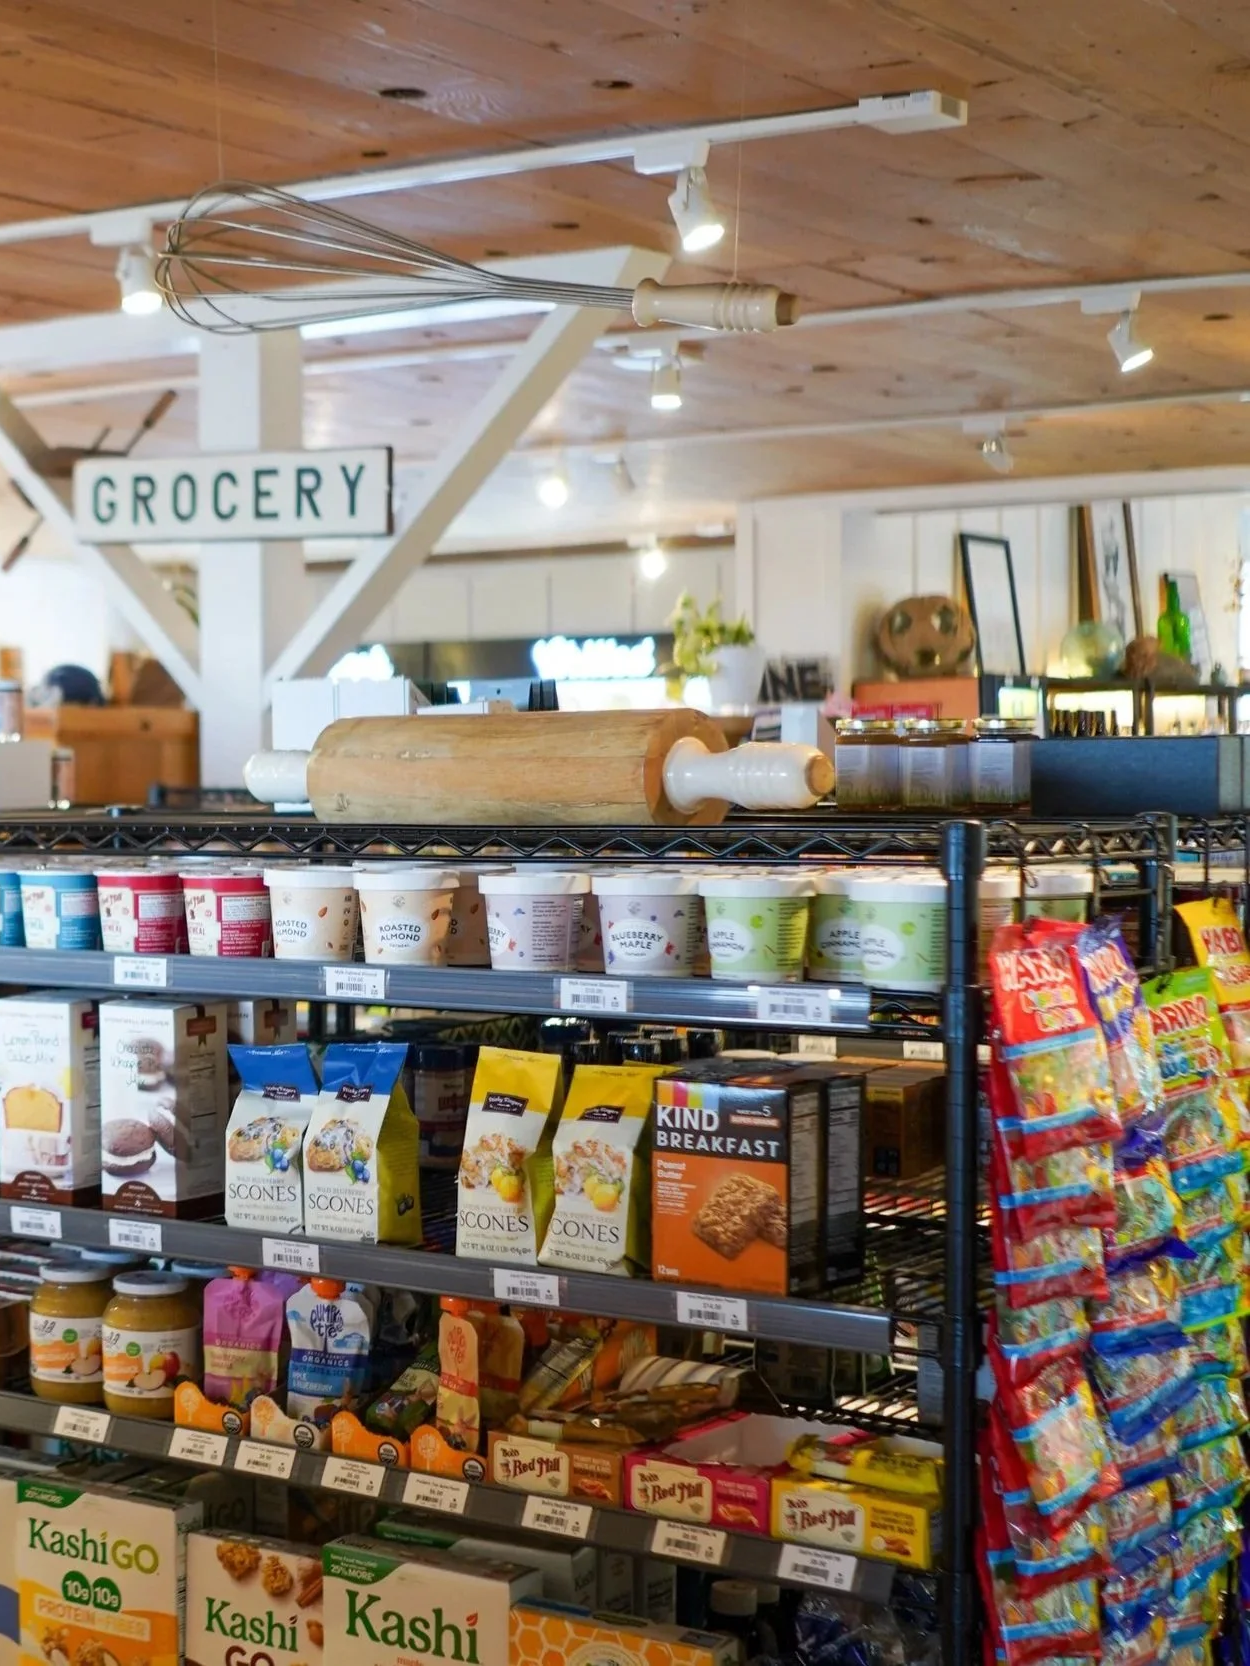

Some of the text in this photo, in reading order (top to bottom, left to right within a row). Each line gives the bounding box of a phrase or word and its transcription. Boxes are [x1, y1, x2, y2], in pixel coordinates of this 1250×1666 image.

[92, 464, 364, 525] GROCERY
[379, 923, 421, 934] ROASTED
[380, 932, 421, 943] ALMOND
[611, 931, 664, 943] BLUEBERRY
[829, 930, 861, 940] APPLE
[619, 940, 653, 950] MAPLE
[1146, 993, 1212, 1037] ARIBO
[656, 1105, 719, 1132] KIND
[762, 1105, 772, 1117] 5
[656, 1131, 780, 1158] BREAKFAST
[657, 1160, 687, 1170] Peanut
[657, 1170, 683, 1180] Butter
[228, 1183, 297, 1202] SCONES
[308, 1193, 374, 1216] SCONES
[459, 1210, 529, 1233] SCONES
[550, 1218, 620, 1244] CONES
[302, 1355, 350, 1367] ORGANICS
[513, 1456, 561, 1478] Red Mill
[651, 1483, 676, 1504] Red
[677, 1482, 704, 1504] Mill
[800, 1510, 827, 1530] Red
[827, 1508, 857, 1531] Mill
[28, 1517, 159, 1575] Kashi GO
[331, 1564, 348, 1576] 25%
[65, 1580, 119, 1607] 10g 10g
[38, 1598, 96, 1625] PROTEIN
[205, 1597, 299, 1652] Kashi
[346, 1588, 480, 1665] Kashi
